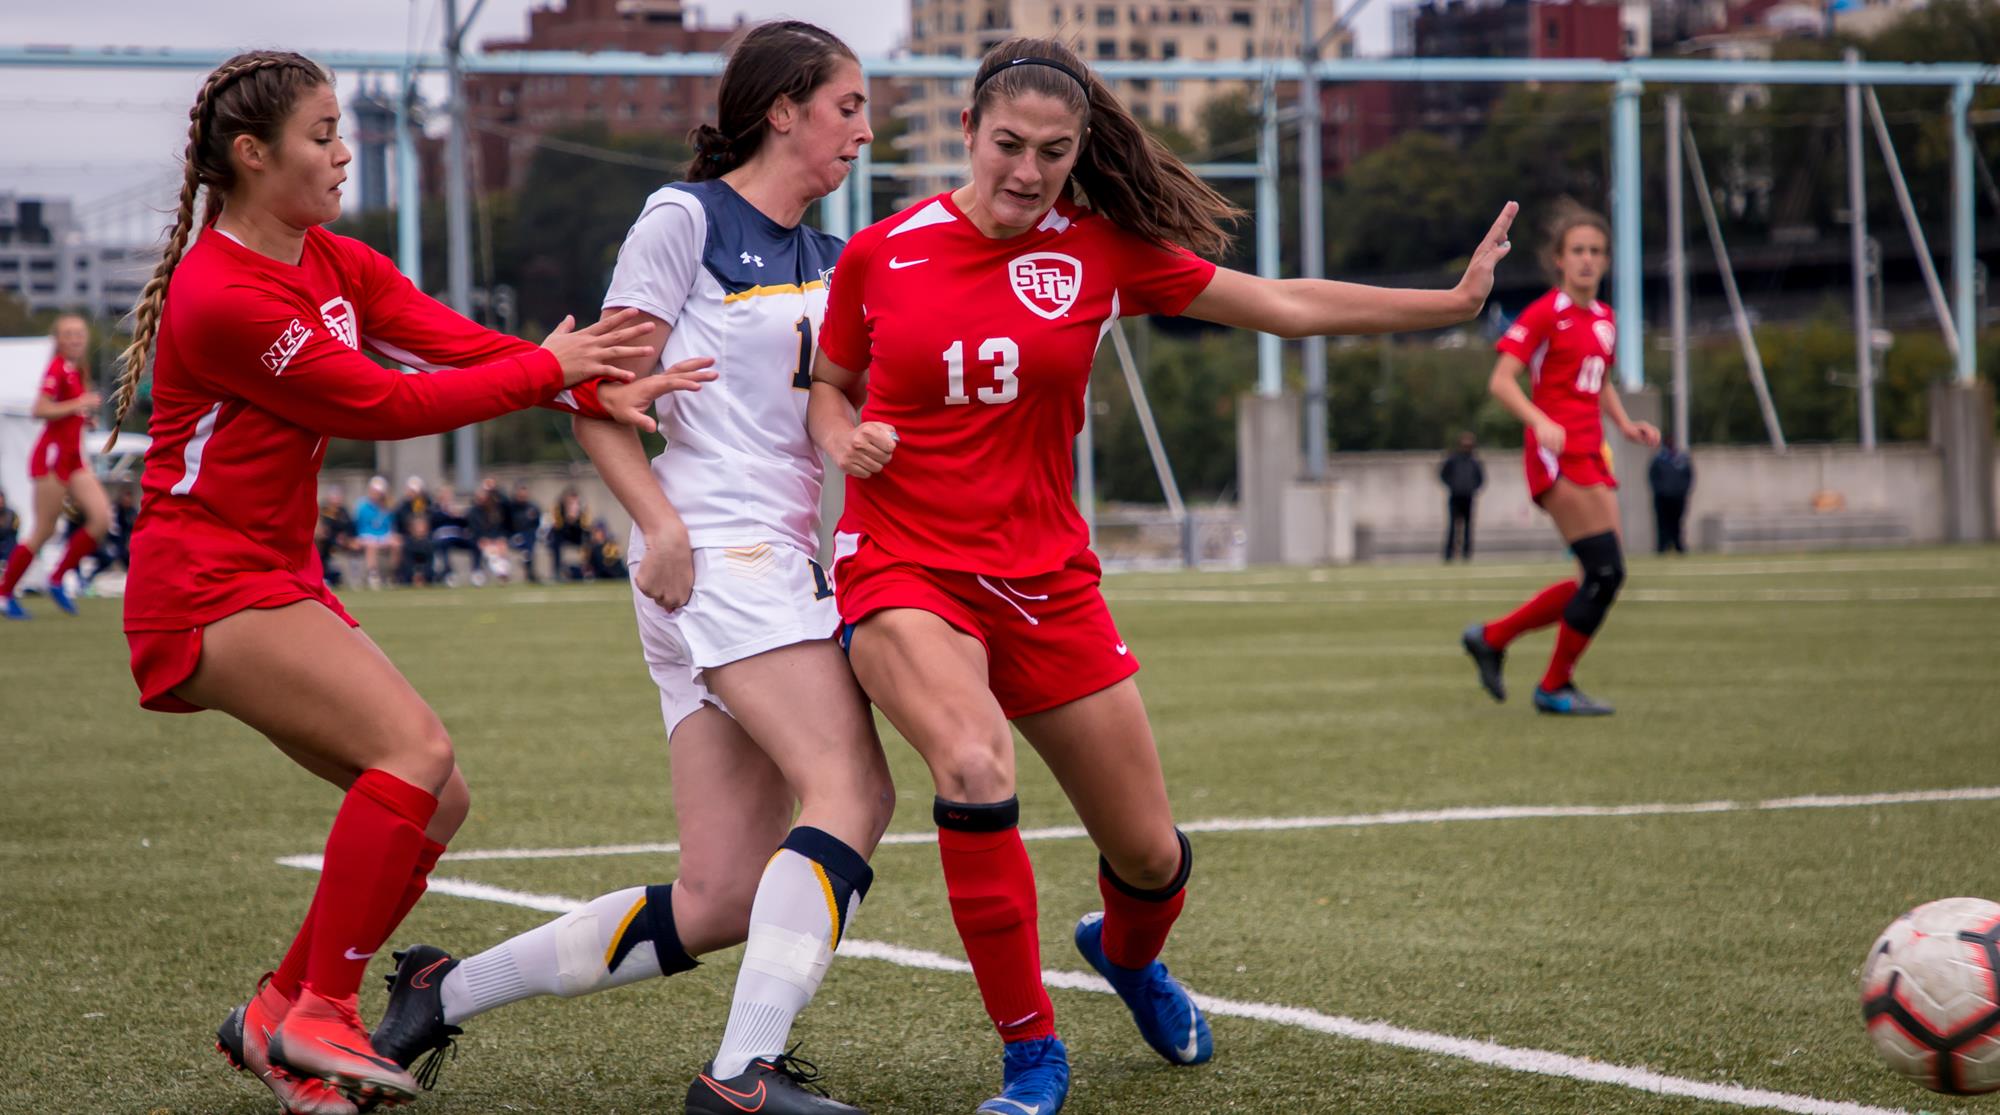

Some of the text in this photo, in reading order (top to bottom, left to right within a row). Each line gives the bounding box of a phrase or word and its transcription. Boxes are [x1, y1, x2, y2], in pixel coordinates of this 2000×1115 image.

[1015, 262, 1073, 303] SFC
[261, 318, 306, 371] NEC
[792, 316, 824, 389] 1
[942, 336, 1019, 405] 13
